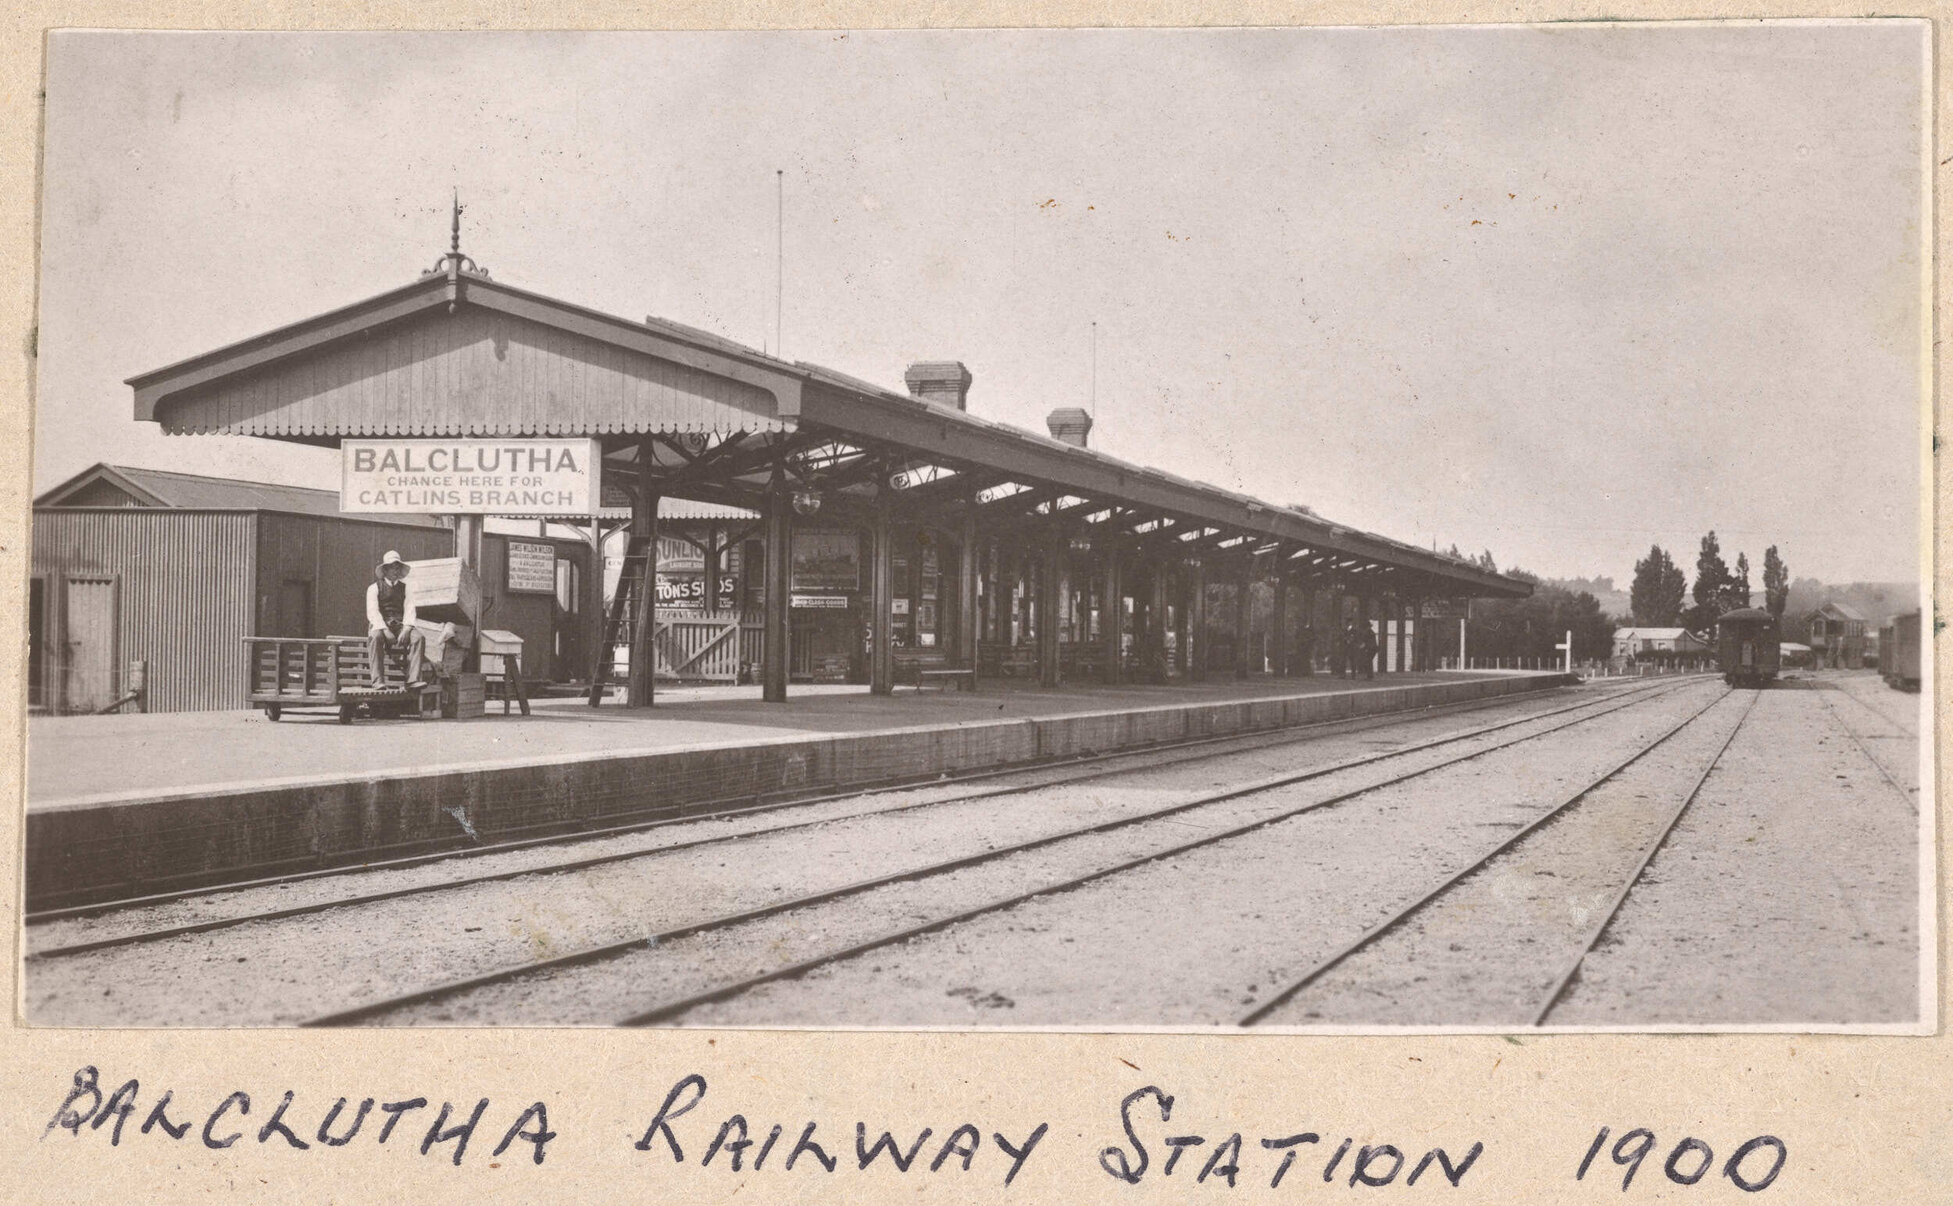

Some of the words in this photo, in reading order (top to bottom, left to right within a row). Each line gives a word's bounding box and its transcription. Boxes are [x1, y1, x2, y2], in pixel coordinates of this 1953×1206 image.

[354, 448, 578, 472] BALCLUTHA
[387, 476, 452, 487] CHANGE
[459, 476, 503, 487] HERE
[510, 476, 543, 487] FOR
[359, 490, 461, 506] CATLINS
[469, 491, 573, 506] BRANCH
[655, 583, 690, 600] TON'S
[44, 1065, 557, 1167] BALCLUTHA
[634, 1073, 1050, 1185] RAILWAY
[1099, 1085, 1484, 1189] STATION
[1576, 1127, 1788, 1193] 1900
